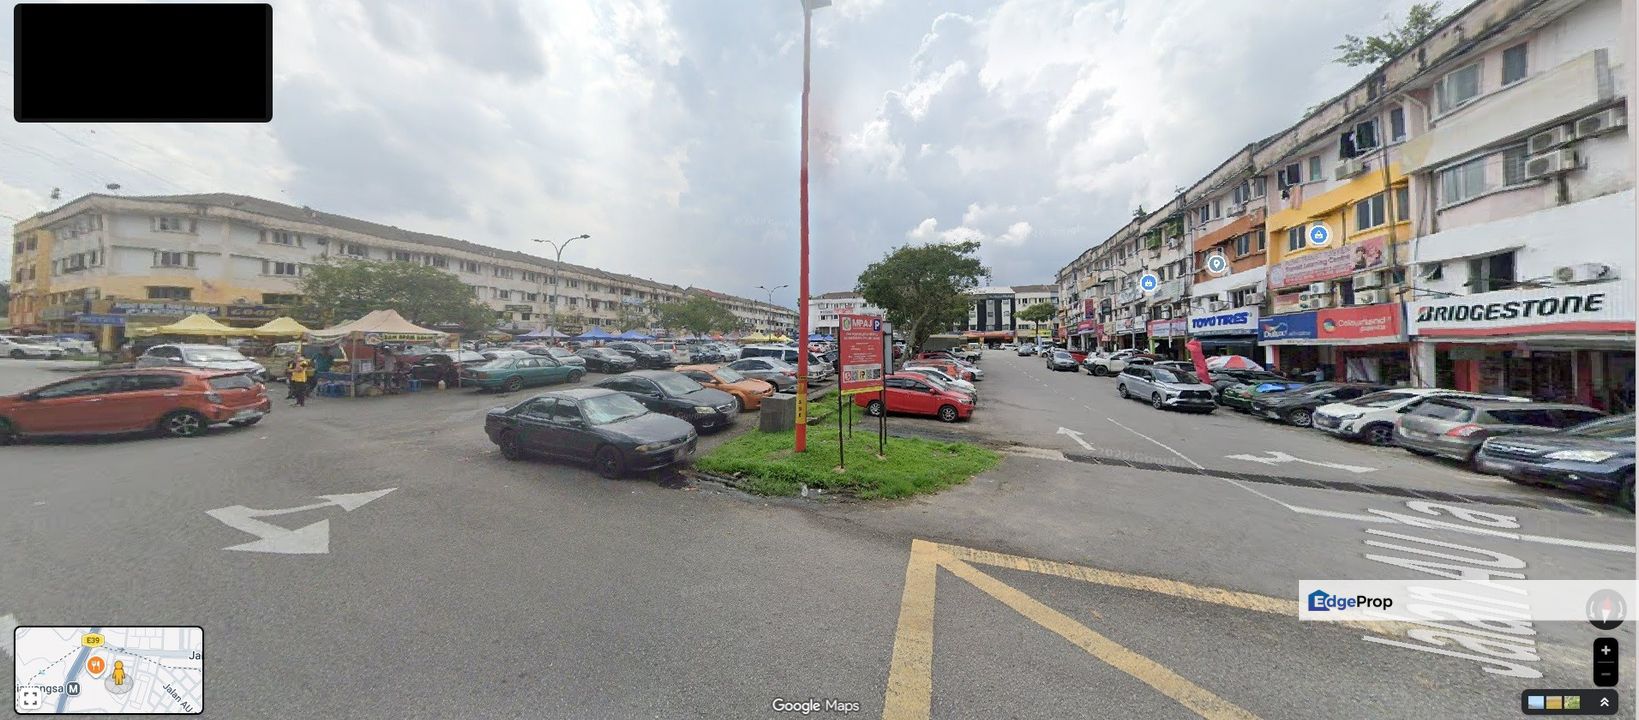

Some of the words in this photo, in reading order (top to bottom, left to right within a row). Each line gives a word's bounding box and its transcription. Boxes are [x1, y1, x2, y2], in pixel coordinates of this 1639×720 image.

[1417, 293, 1605, 322] BRIDGESTONE
[852, 319, 872, 328] MPAJ
[874, 321, 880, 330] P
[1192, 315, 1215, 328] TOYO
[1216, 312, 1249, 325] TIRES
